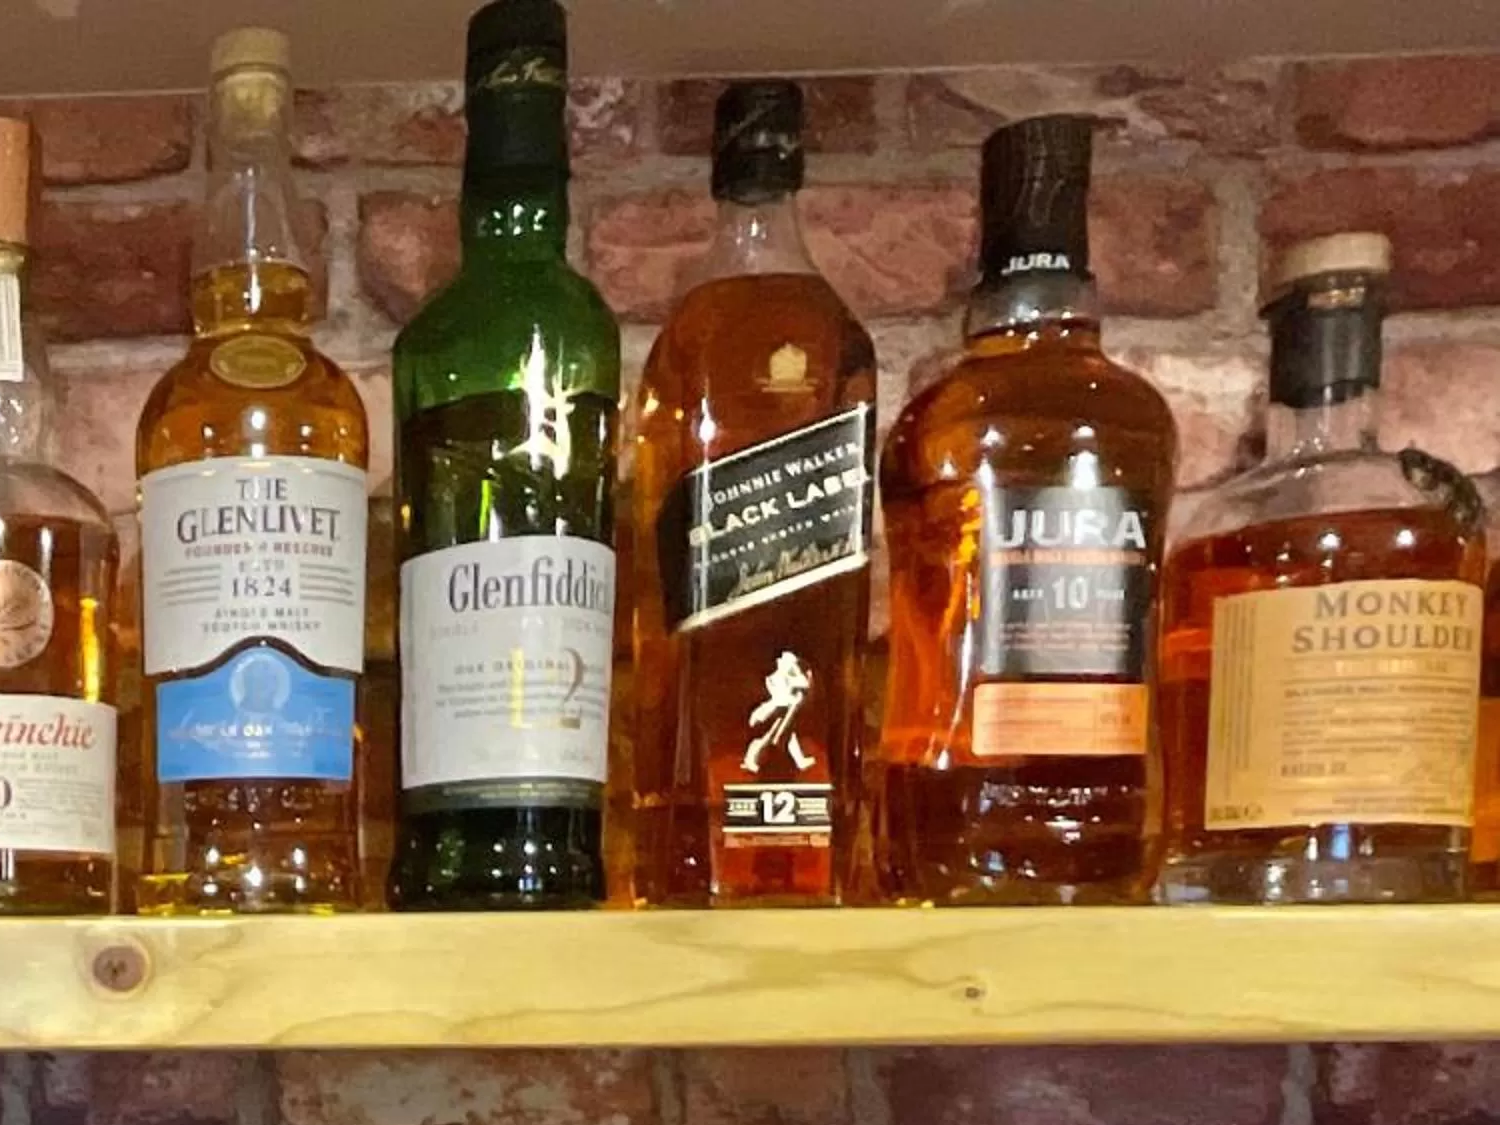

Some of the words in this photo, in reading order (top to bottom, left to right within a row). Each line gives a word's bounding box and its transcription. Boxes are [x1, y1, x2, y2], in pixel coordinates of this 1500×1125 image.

[1001, 253, 1070, 273] JURA
[235, 478, 287, 501] THE
[177, 505, 341, 545] GLENLIVET
[996, 510, 1148, 549] JURA
[232, 576, 292, 598] 1824
[1052, 576, 1088, 609] 10
[1314, 591, 1468, 620] MONKEY
[760, 791, 796, 823] 12
